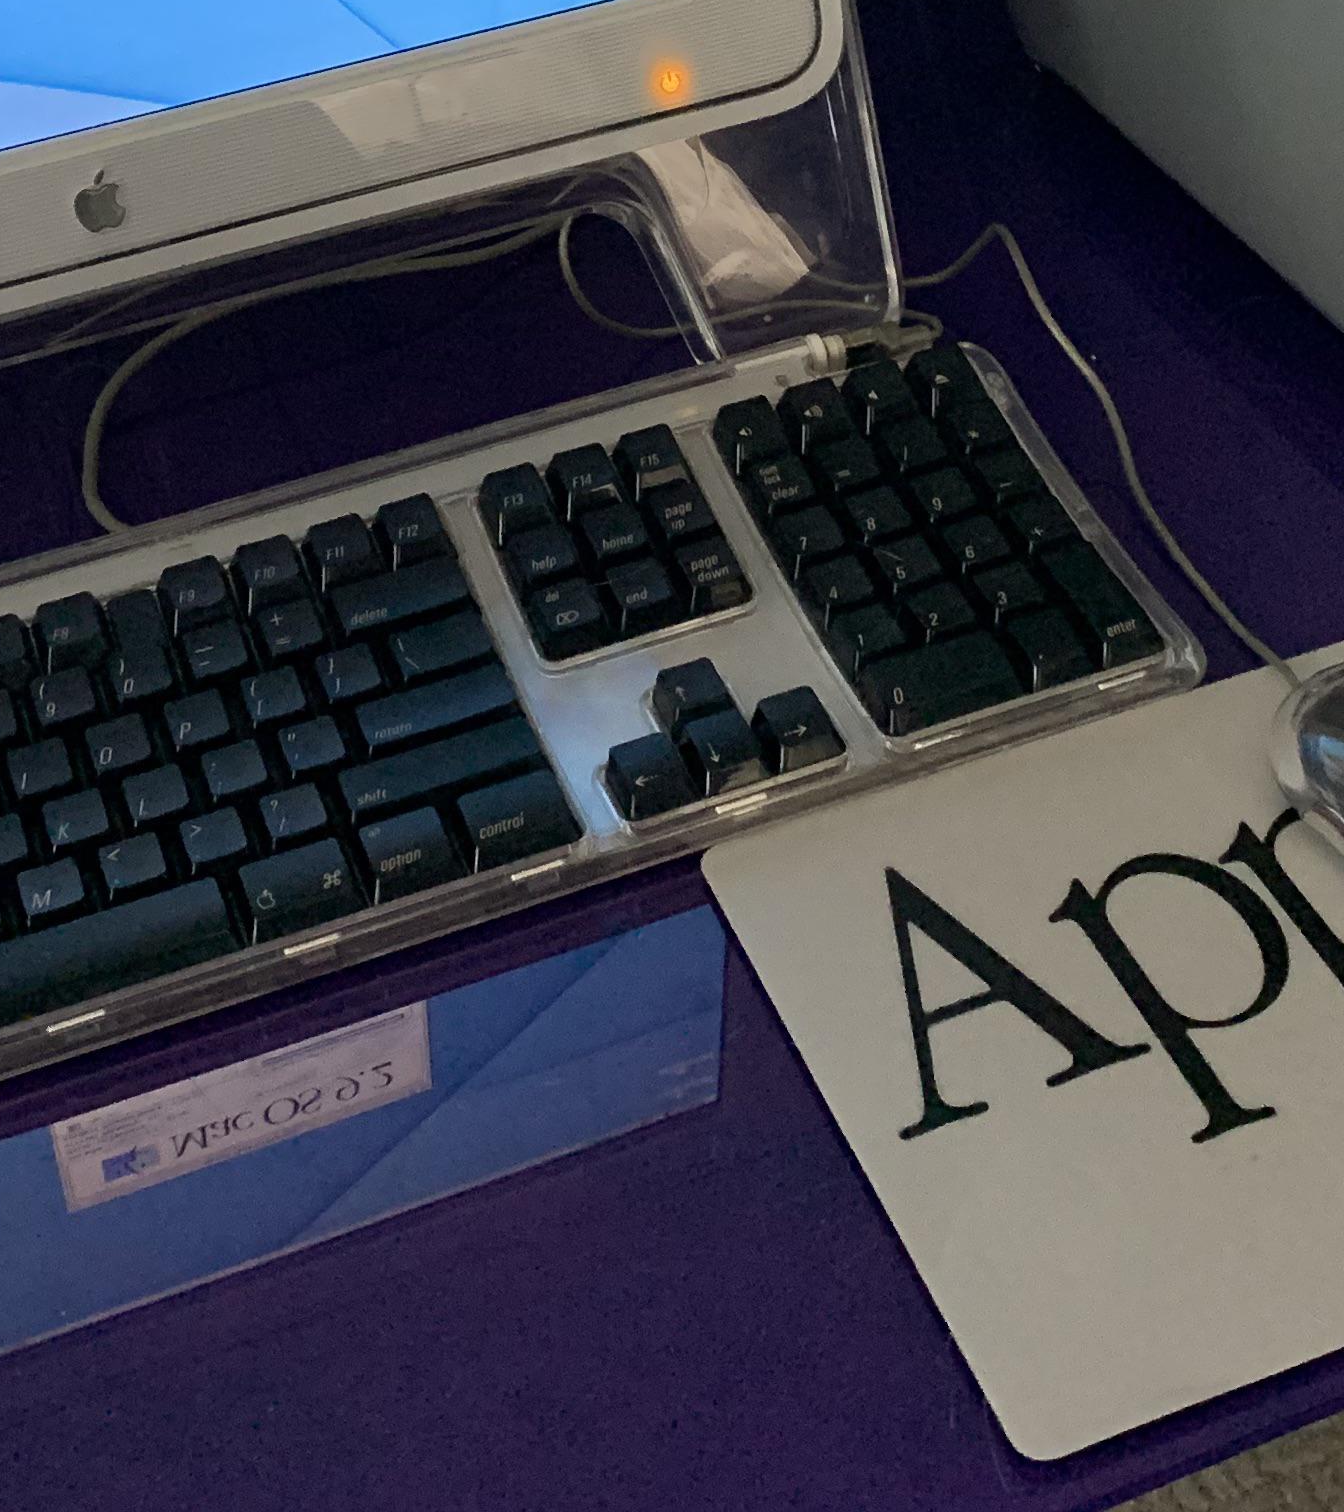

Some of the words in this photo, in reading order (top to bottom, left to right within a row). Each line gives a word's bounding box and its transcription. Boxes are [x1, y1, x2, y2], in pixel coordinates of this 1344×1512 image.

[640, 454, 659, 467] F15
[572, 473, 592, 488] F14
[503, 492, 524, 507] F13
[931, 497, 943, 512] 9
[664, 501, 693, 520] page
[398, 524, 419, 539] F12
[672, 517, 686, 531] up
[867, 516, 877, 531] 8
[602, 533, 634, 551] home
[326, 545, 345, 561] F11
[531, 555, 558, 572] help
[690, 554, 719, 573] page
[254, 565, 276, 580] F10
[697, 565, 730, 583] down
[179, 590, 195, 605] F9
[544, 591, 560, 603] del
[626, 588, 648, 605] end
[351, 607, 389, 626] delete
[53, 627, 70, 641] F8
[1106, 617, 1139, 639] enter
[357, 788, 388, 806] shift
[479, 811, 526, 840] control
[380, 848, 421, 872] option
[31, 889, 52, 909] M
